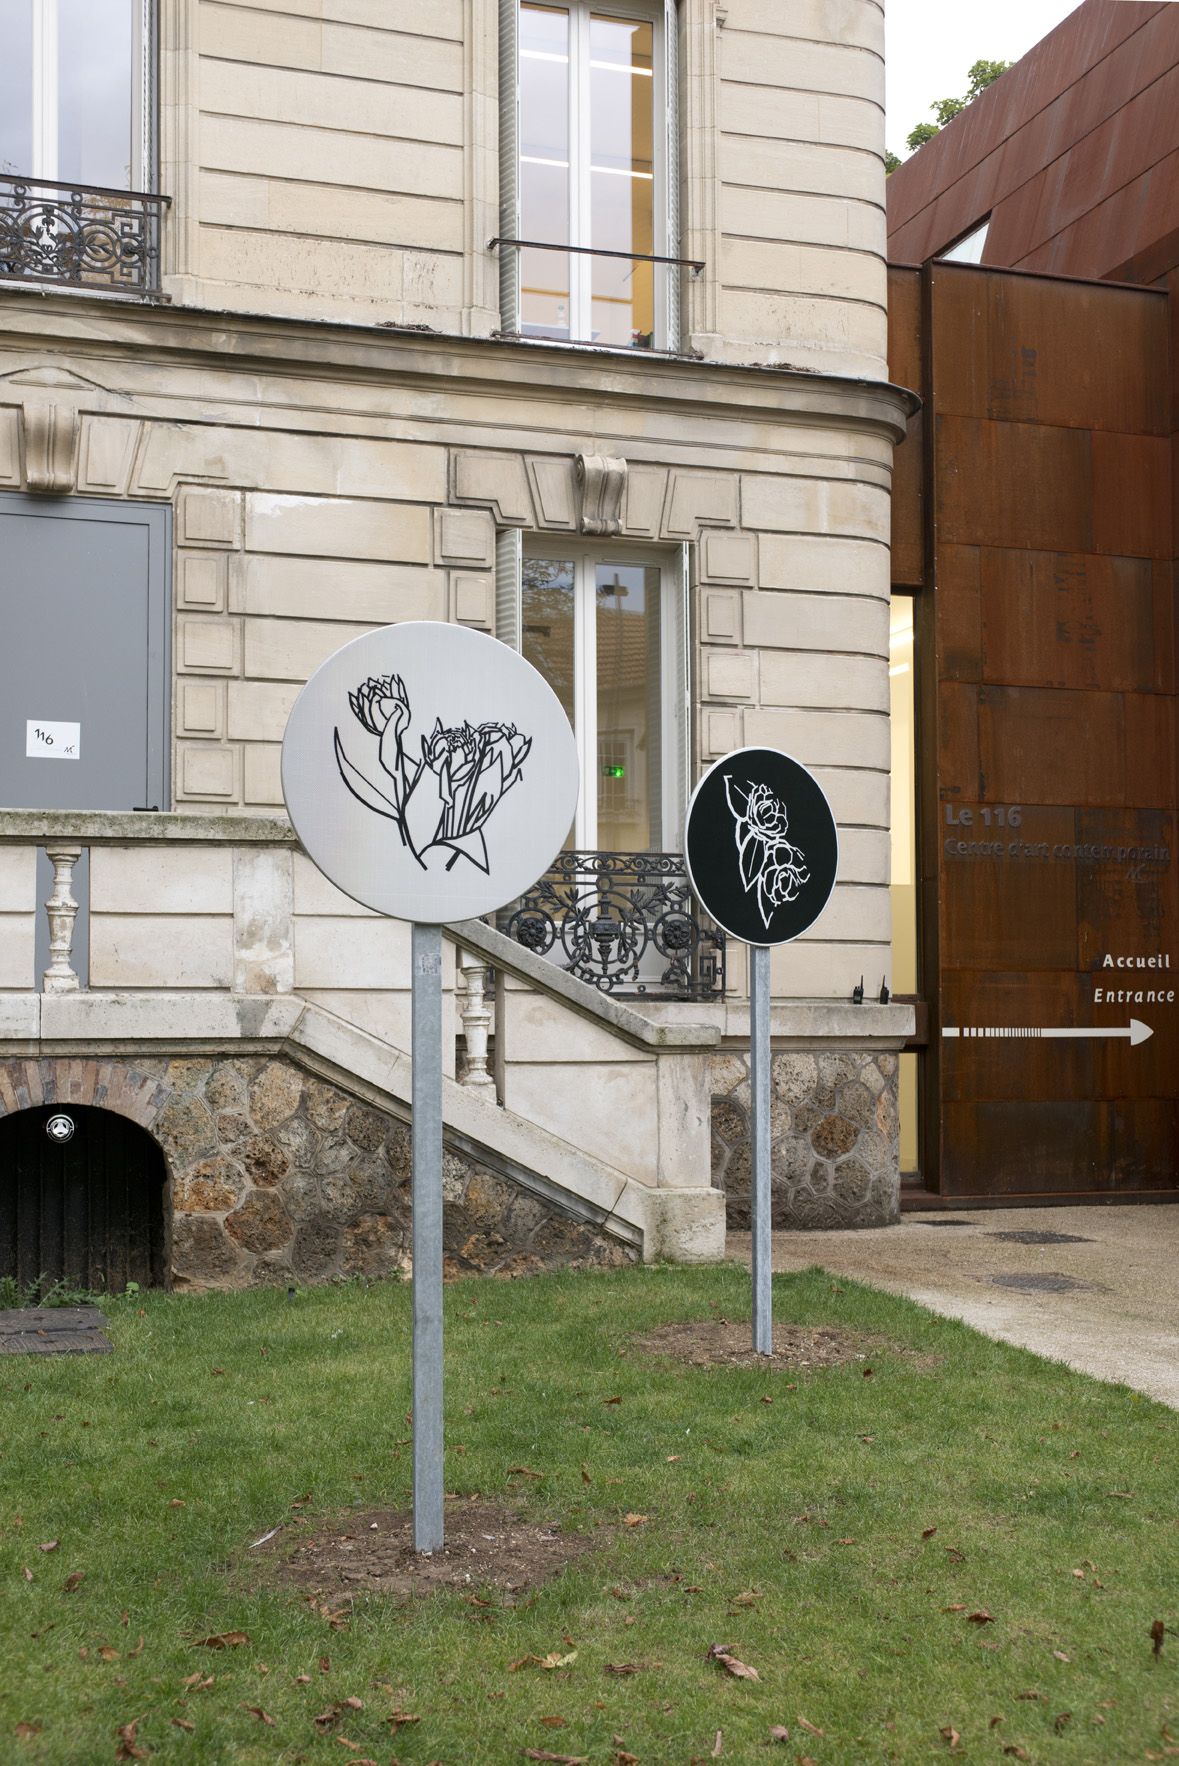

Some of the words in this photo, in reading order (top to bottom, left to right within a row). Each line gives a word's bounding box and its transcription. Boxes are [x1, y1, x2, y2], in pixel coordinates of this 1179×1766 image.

[34, 728, 54, 746] 116
[945, 803, 973, 826] Le
[980, 806, 1023, 828] 116
[944, 837, 1005, 857] Centre
[1102, 953, 1170, 969] Accueil
[1093, 987, 1175, 1003] Entrance
